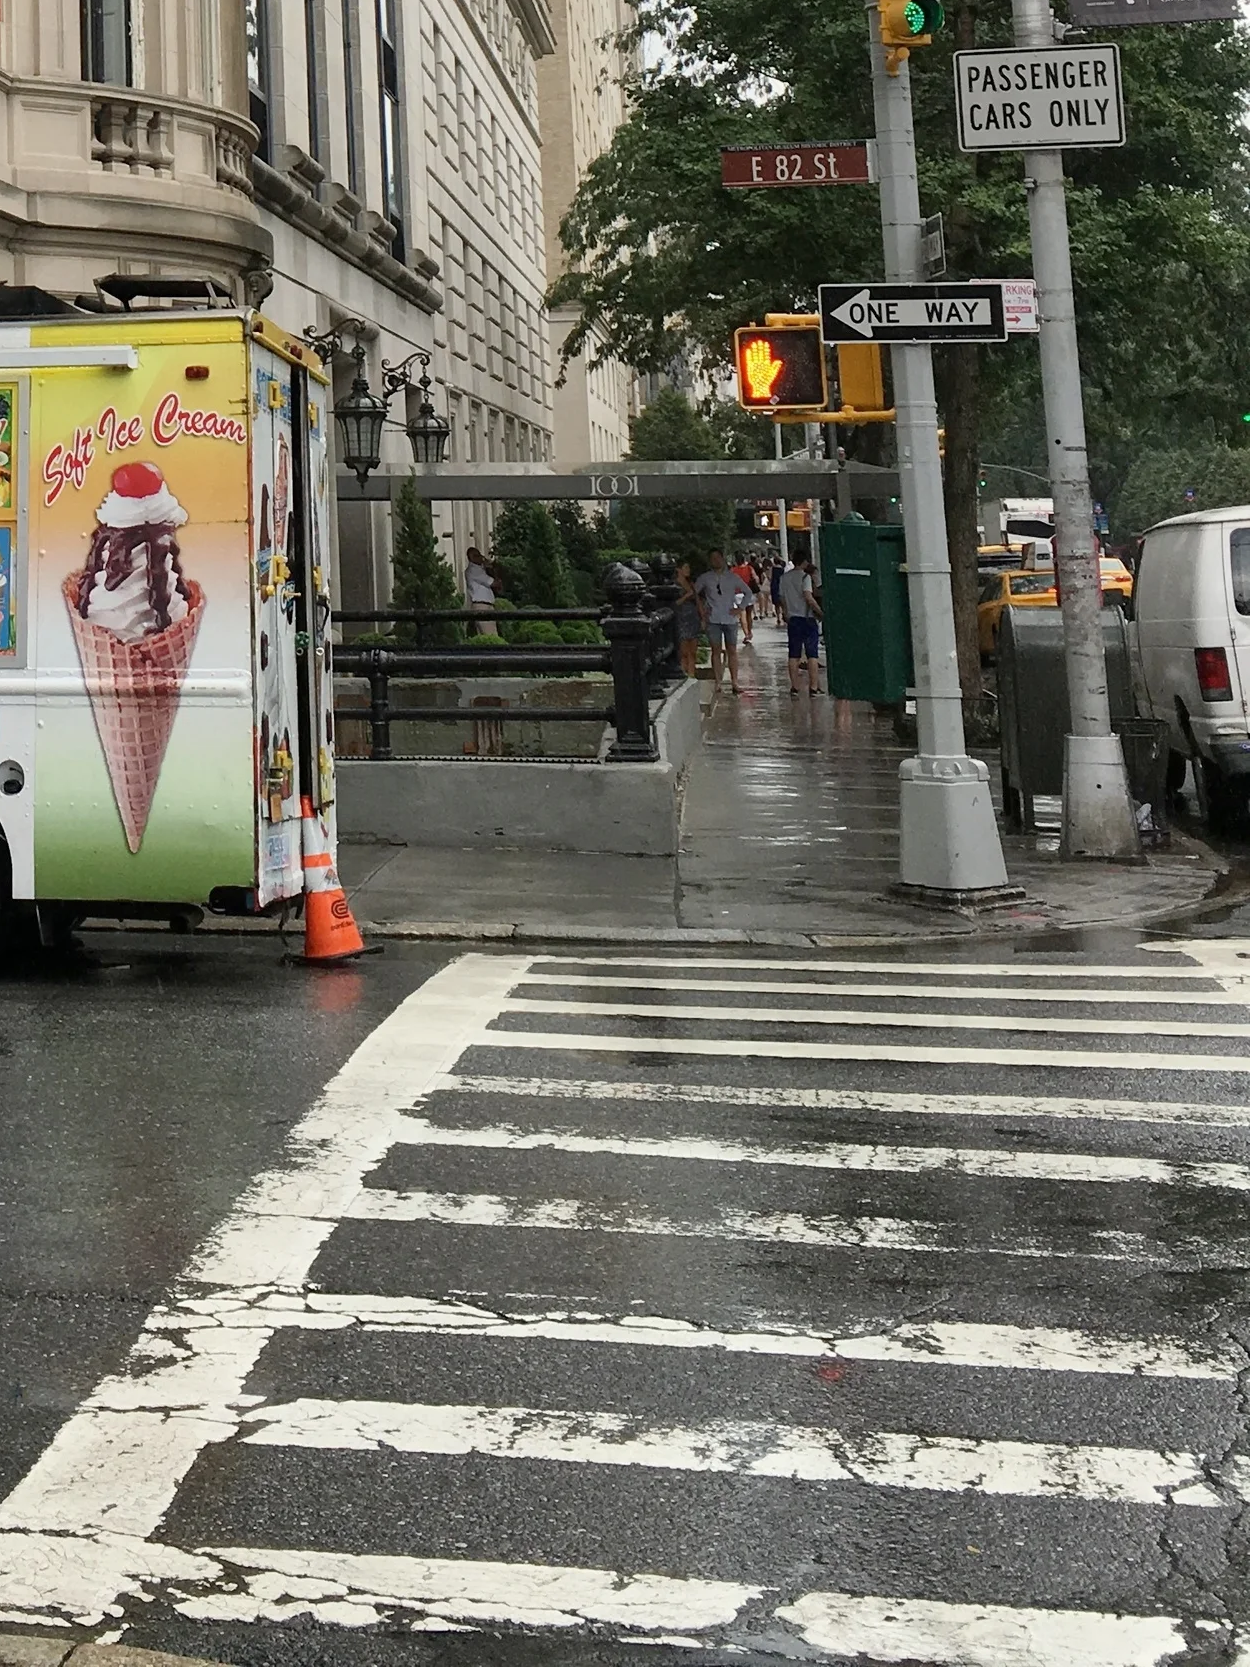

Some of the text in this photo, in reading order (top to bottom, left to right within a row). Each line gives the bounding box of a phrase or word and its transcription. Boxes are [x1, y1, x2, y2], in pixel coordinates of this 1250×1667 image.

[967, 60, 1108, 92] PASSENGER
[969, 98, 1109, 131] CARS ONLY
[751, 152, 840, 181] E 82 St
[1005, 285, 1033, 296] RKING
[849, 301, 979, 324] ONE WAY
[44, 427, 94, 506] Soft
[98, 406, 144, 453] Ice
[152, 391, 247, 446] Cream
[590, 475, 640, 497] 1001
